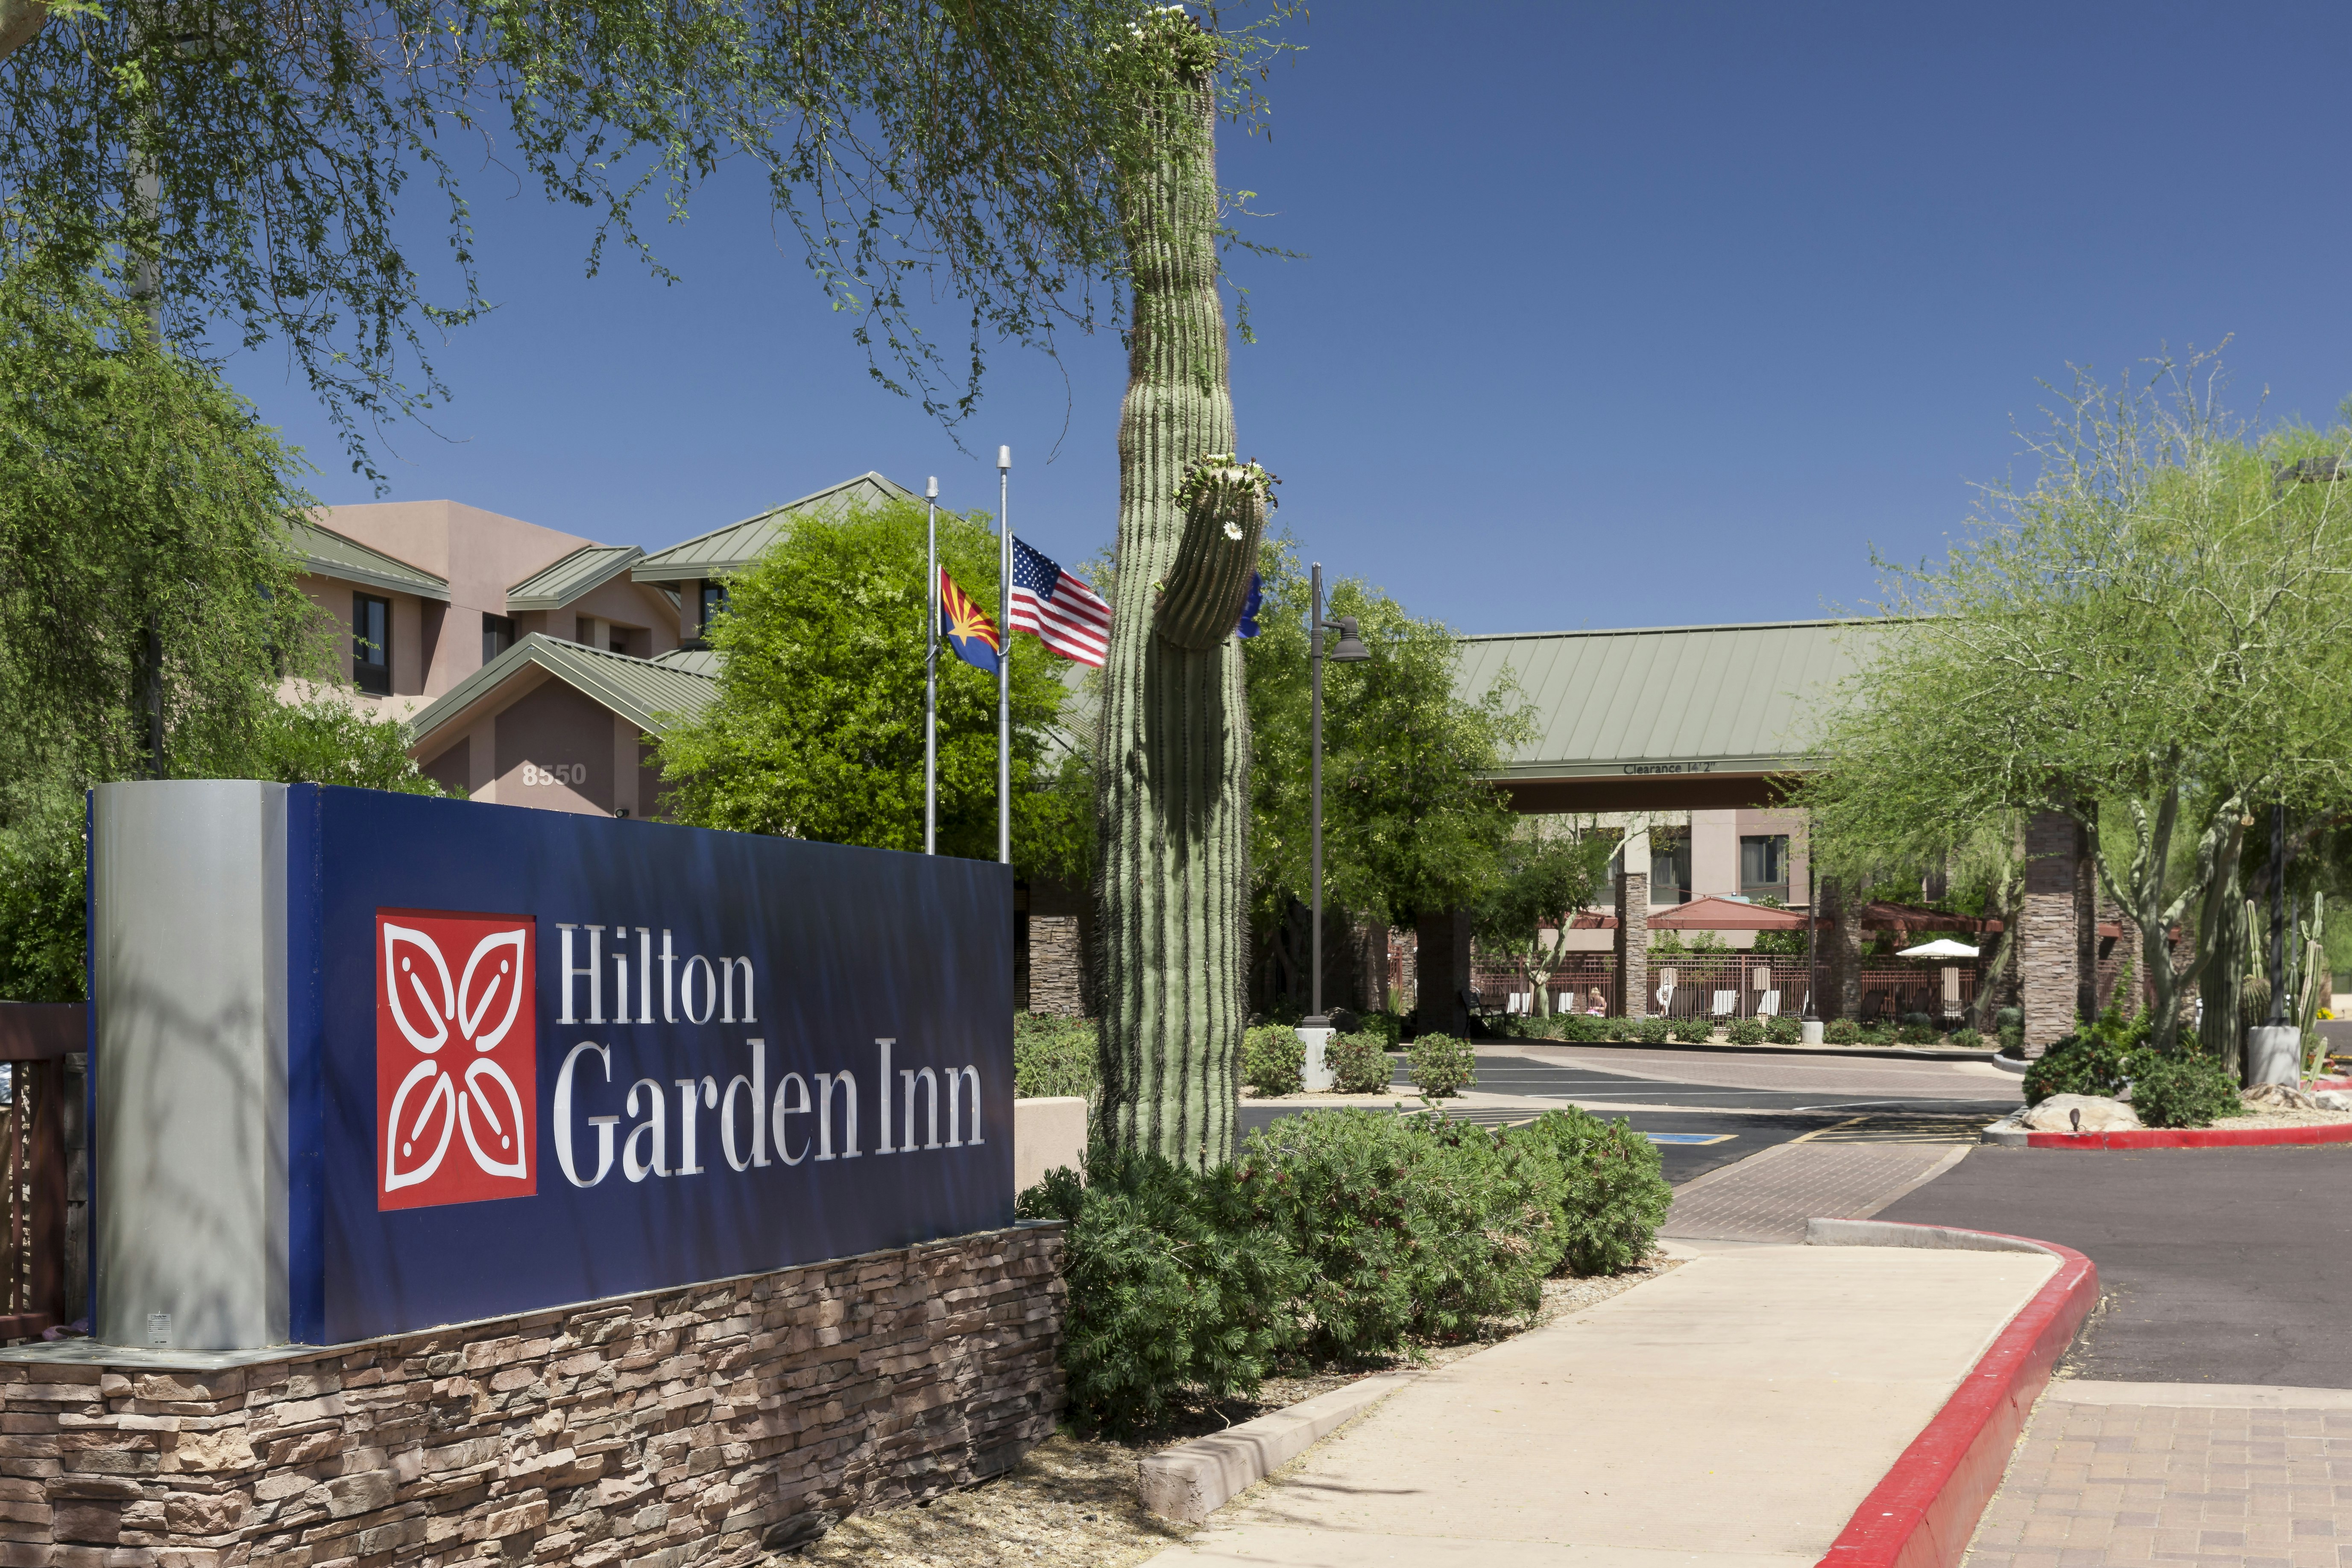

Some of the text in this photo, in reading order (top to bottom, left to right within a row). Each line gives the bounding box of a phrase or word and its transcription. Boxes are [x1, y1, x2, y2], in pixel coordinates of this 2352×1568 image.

[523, 763, 586, 786] 8550
[1624, 764, 1681, 774] Clearance
[556, 923, 758, 1025] Hilton
[554, 1038, 985, 1188] Garden Inn
